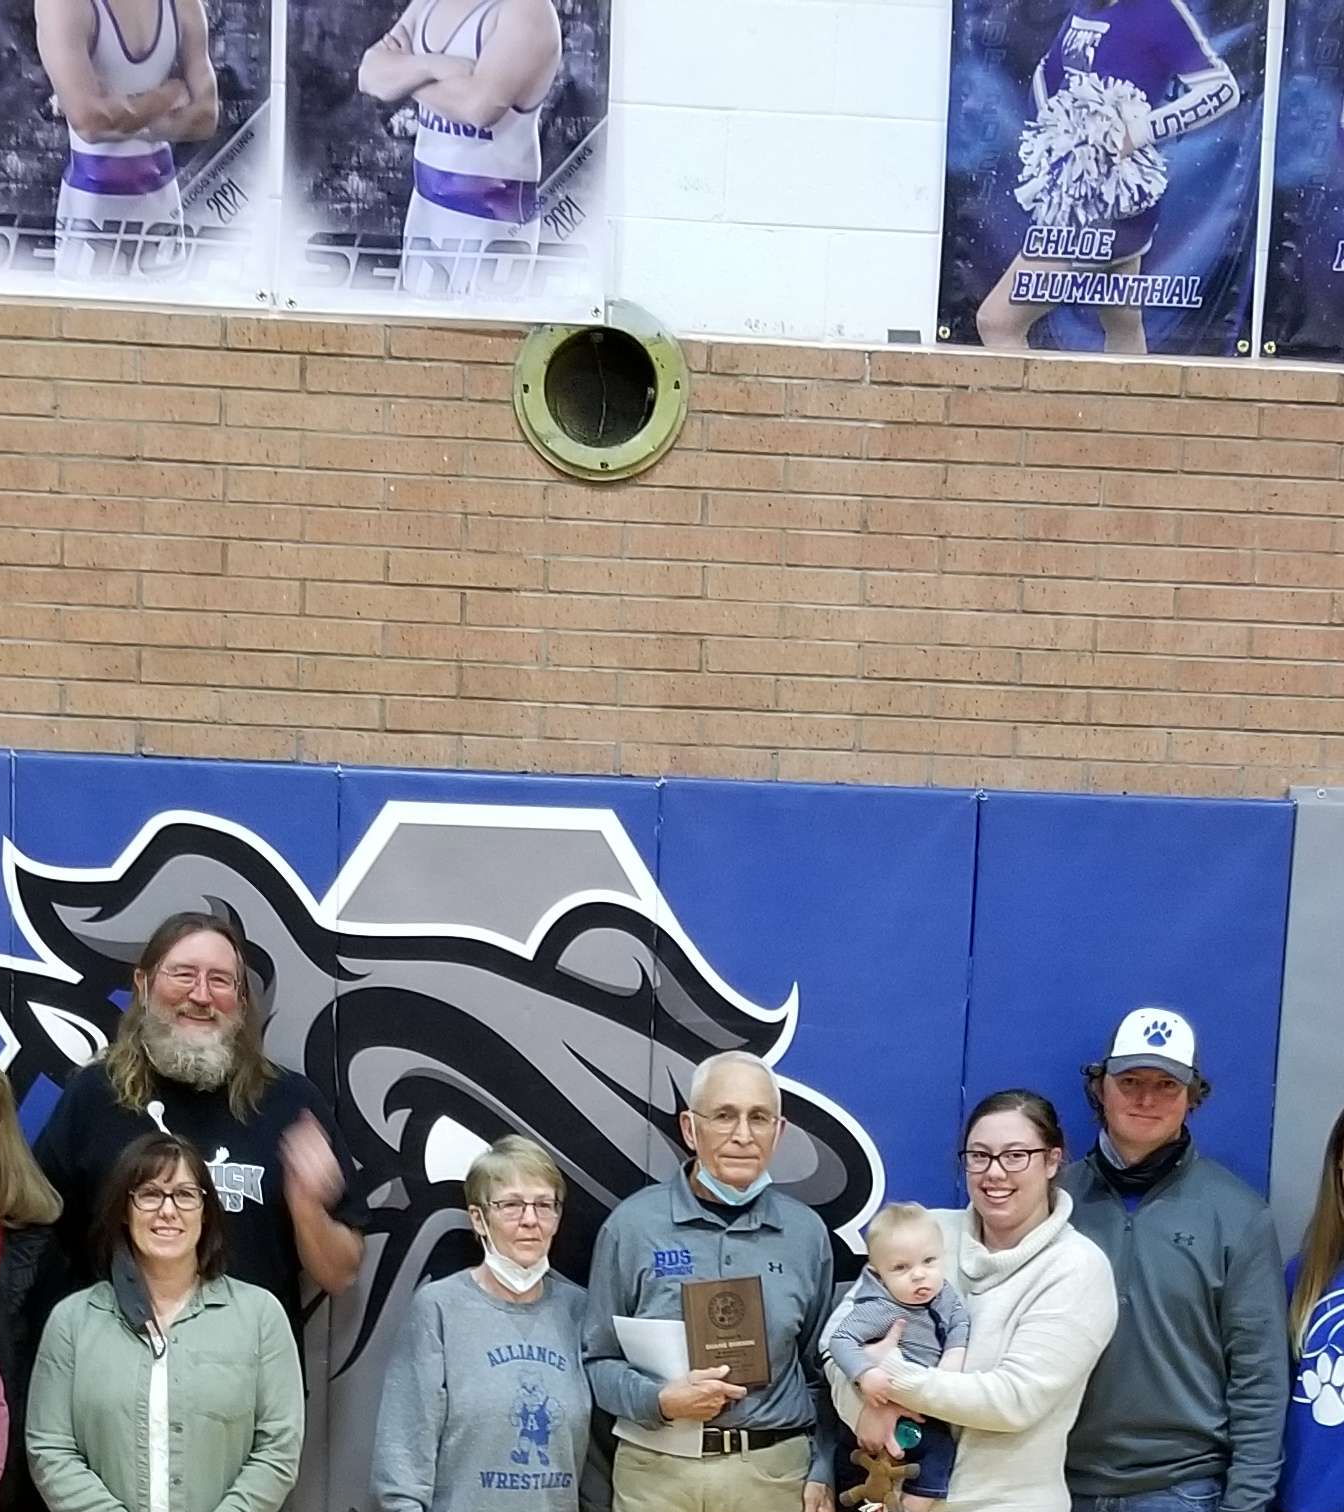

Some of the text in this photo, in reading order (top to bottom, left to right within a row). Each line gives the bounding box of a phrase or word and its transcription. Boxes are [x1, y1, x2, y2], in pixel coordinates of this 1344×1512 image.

[206, 177, 249, 225] 2021
[543, 193, 587, 242] 2021
[1023, 225, 1115, 260] CHLOE
[1011, 270, 1202, 307] BLUMANTHAL
[207, 1164, 264, 1204] ICK
[486, 1344, 567, 1372] ALLIANCE
